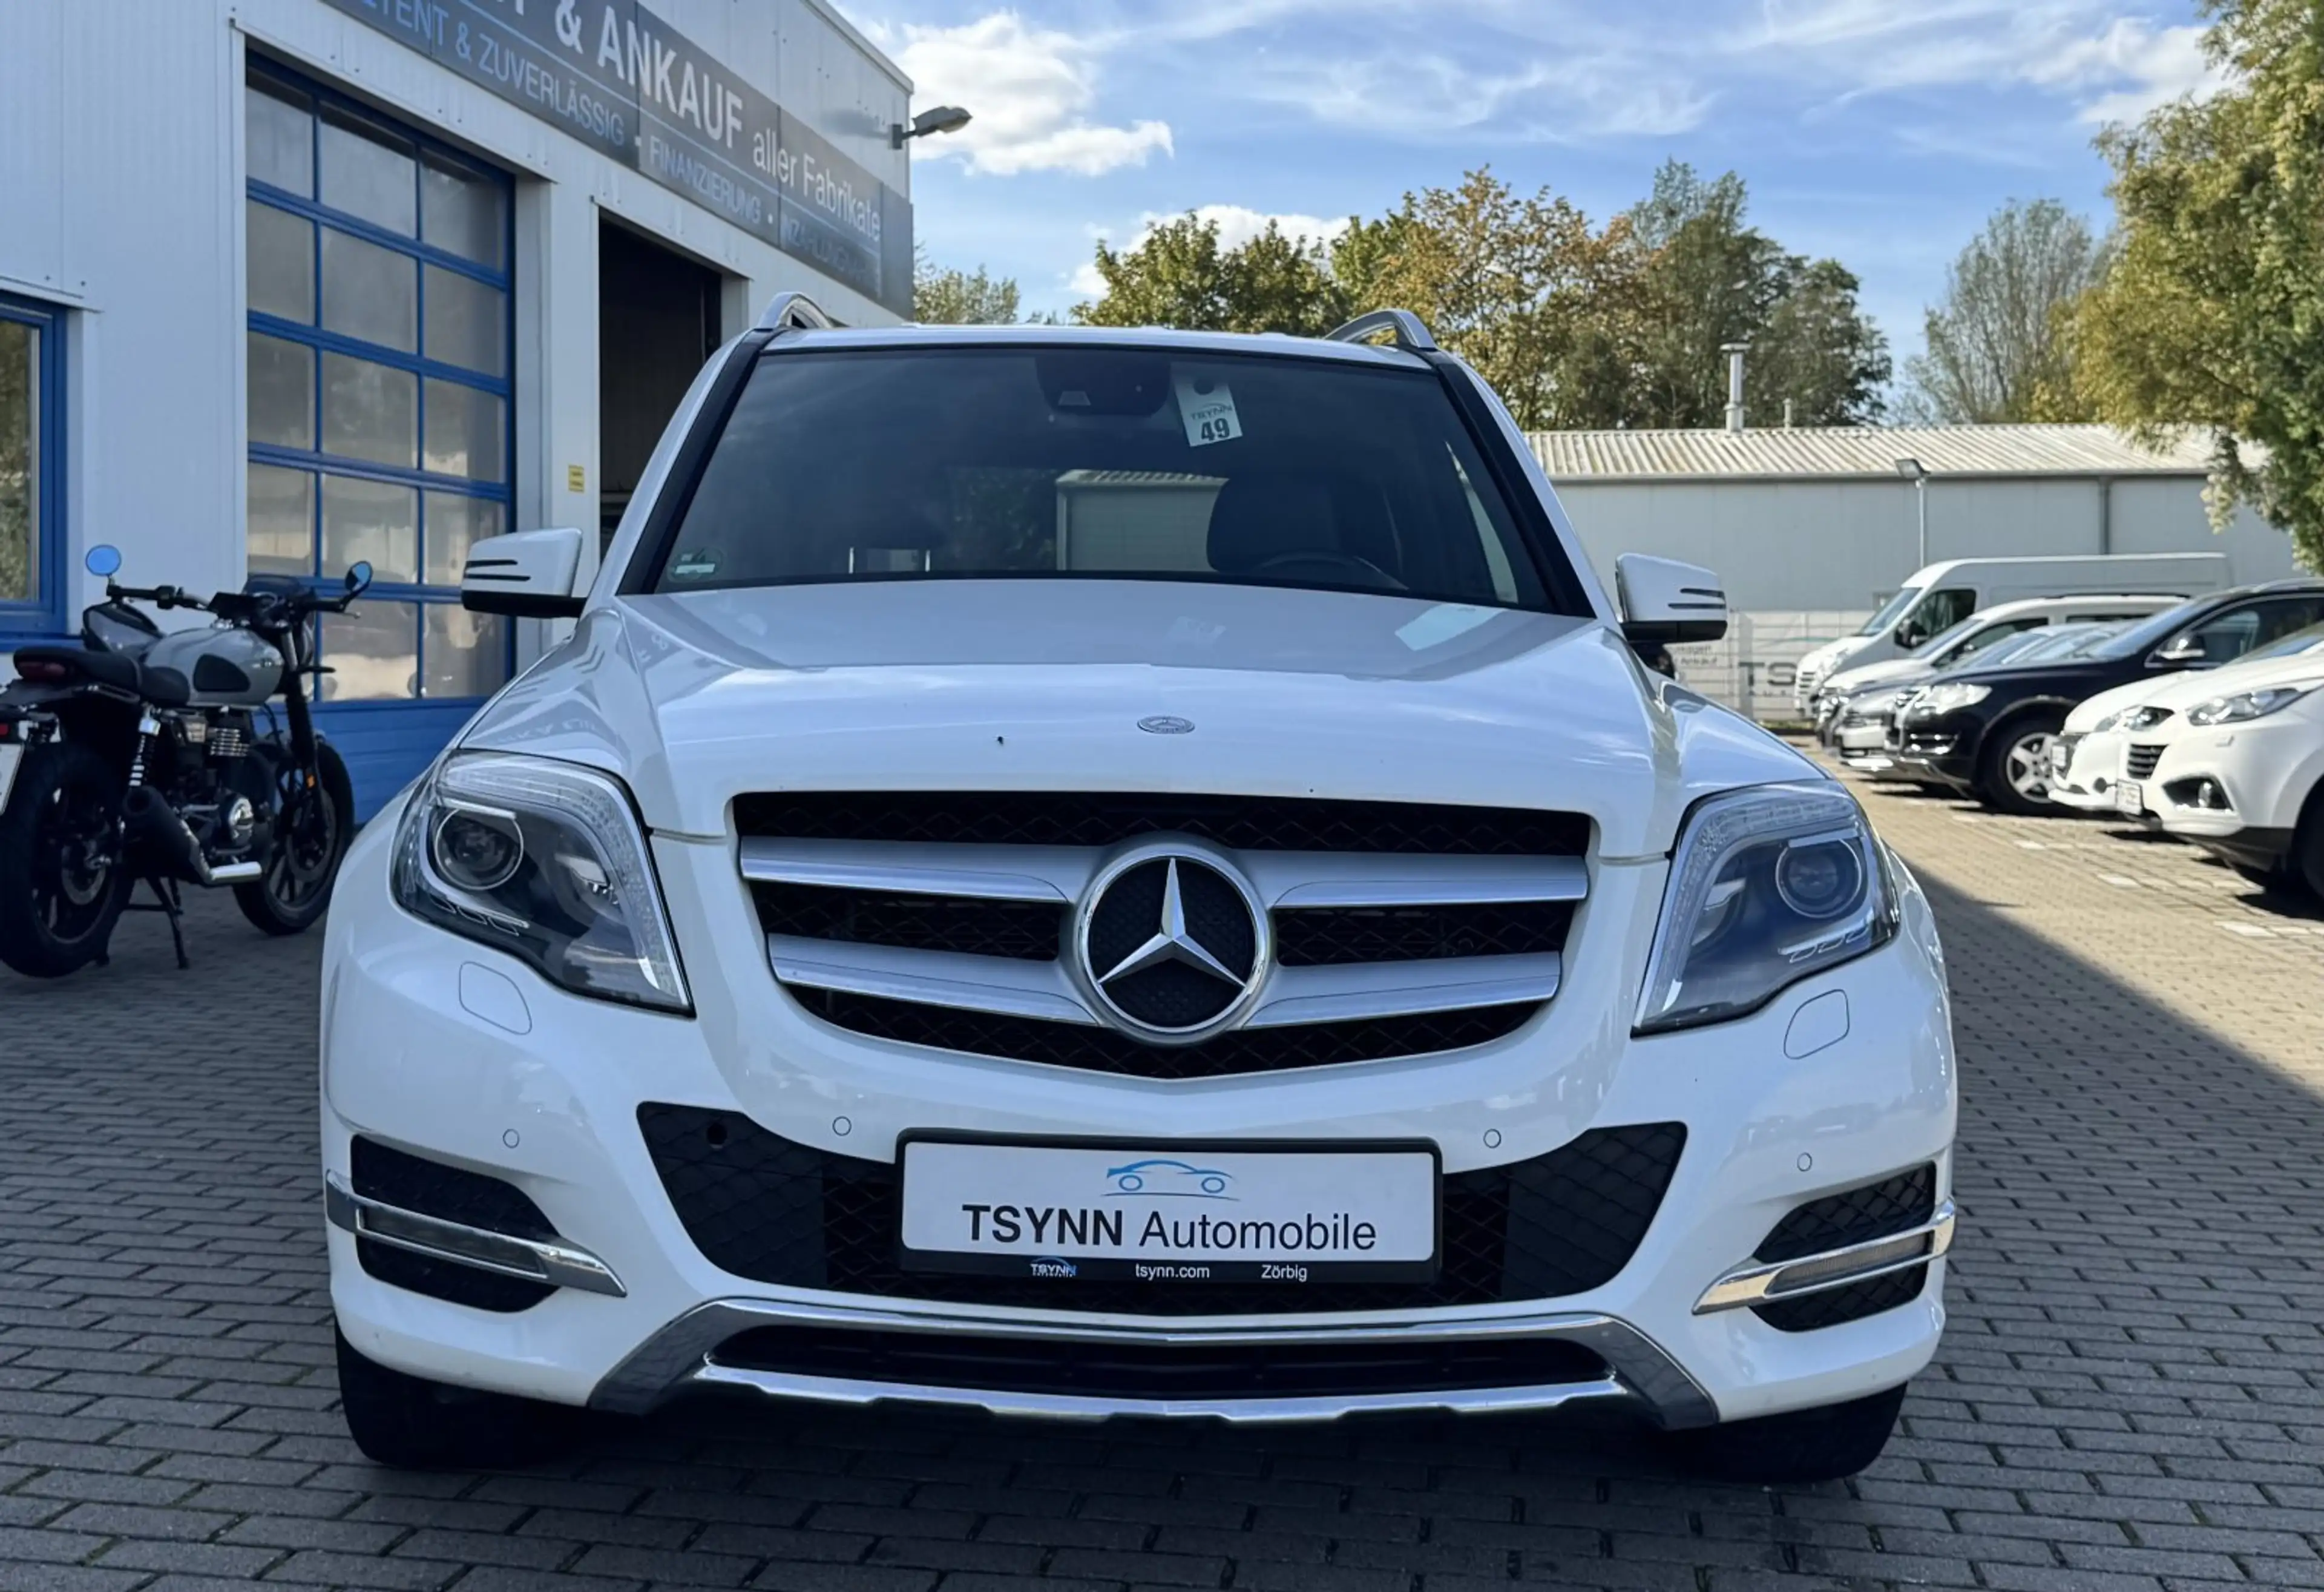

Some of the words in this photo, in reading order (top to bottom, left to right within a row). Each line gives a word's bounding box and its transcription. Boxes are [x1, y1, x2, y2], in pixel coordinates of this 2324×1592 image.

[456, 21, 472, 63] &
[478, 33, 625, 147] ZUVERLÄSSIG
[649, 135, 761, 224] FINANZIERUNG
[555, 0, 583, 54] &
[597, 5, 743, 149] ANKAUF
[753, 128, 797, 189] aller
[803, 153, 881, 242] Fabrikate
[1201, 418, 1230, 441] 49
[962, 1204, 1123, 1246] TSYNN
[1138, 1211, 1377, 1251] Automobile
[1135, 1263, 1210, 1281] tsynn.com
[1261, 1264, 1308, 1282] Zörbig
